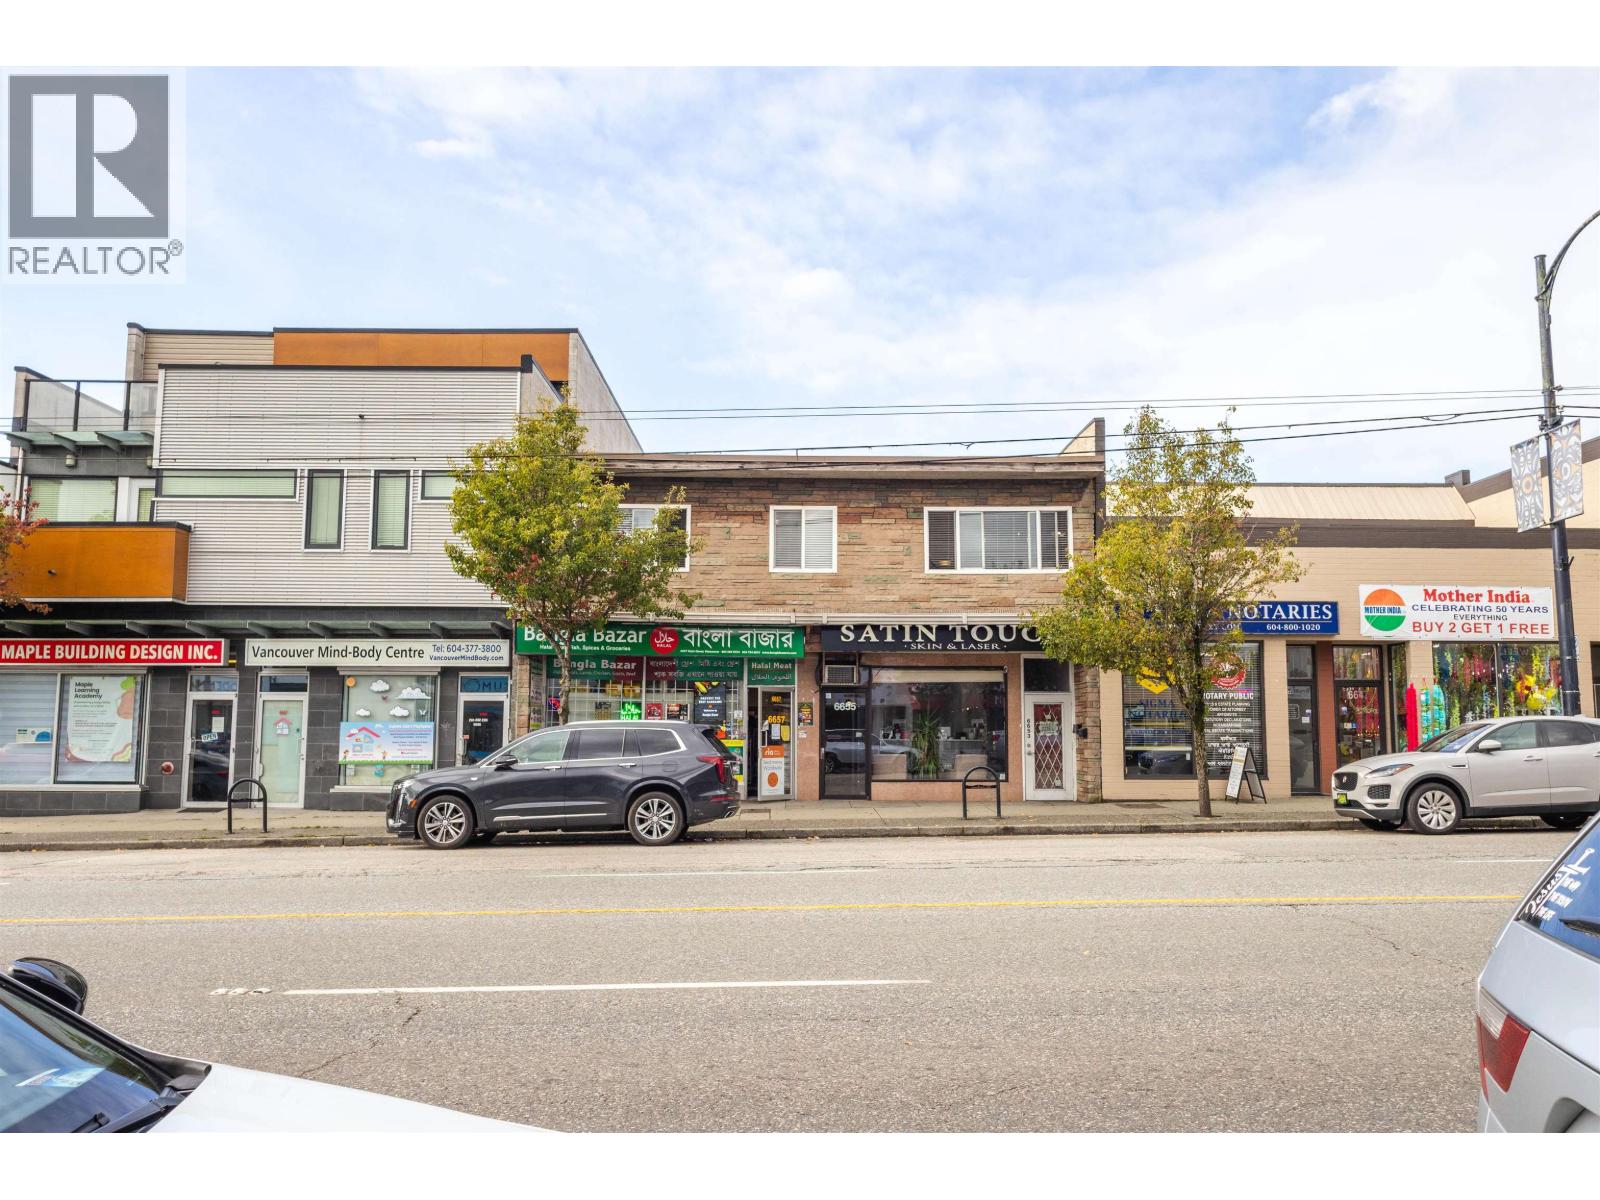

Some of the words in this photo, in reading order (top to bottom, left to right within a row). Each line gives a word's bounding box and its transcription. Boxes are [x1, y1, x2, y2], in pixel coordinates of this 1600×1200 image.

[1423, 588, 1484, 603] Mother
[1487, 589, 1530, 604] India
[1228, 604, 1333, 619] NOTARIES
[1365, 606, 1386, 614] MOTHER
[1387, 606, 1402, 614] INDIA
[1412, 604, 1492, 613] CELEBRATING
[1495, 605, 1507, 613] 50
[1510, 606, 1549, 614] YEARS
[840, 624, 938, 642] SATIN
[948, 624, 1041, 643] TOUC
[1266, 623, 1321, 631] 604-800-1020
[1412, 622, 1444, 633] BUY
[1448, 622, 1457, 633] 2
[1461, 623, 1492, 634] GET
[1497, 623, 1503, 634] 1
[1509, 623, 1551, 635] FREE
[524, 625, 586, 646] Baga
[593, 628, 647, 643] Bazar
[654, 631, 675, 644] حلال
[682, 627, 735, 649] বাংলা
[738, 627, 795, 649] বাজার
[1, 644, 51, 660] MAPLE
[54, 644, 126, 660] BUILDING
[129, 644, 184, 660] DESIGN
[188, 644, 218, 660] INC.
[432, 644, 445, 653] Tel:
[446, 644, 502, 653] 604-377-3800
[910, 642, 942, 650] SKIN
[946, 642, 958, 650] &
[961, 642, 1000, 650] LASER
[252, 646, 314, 658] Vancouver
[318, 646, 382, 661] Mind-Body
[385, 646, 425, 659] Centre
[553, 658, 596, 670] Bngla
[601, 659, 637, 669] Bazar
[1229, 692, 1254, 700] PUBLIC
[768, 715, 786, 724] 6657
[202, 732, 217, 741] OPEN
[1525, 872, 1562, 914] Jesus
